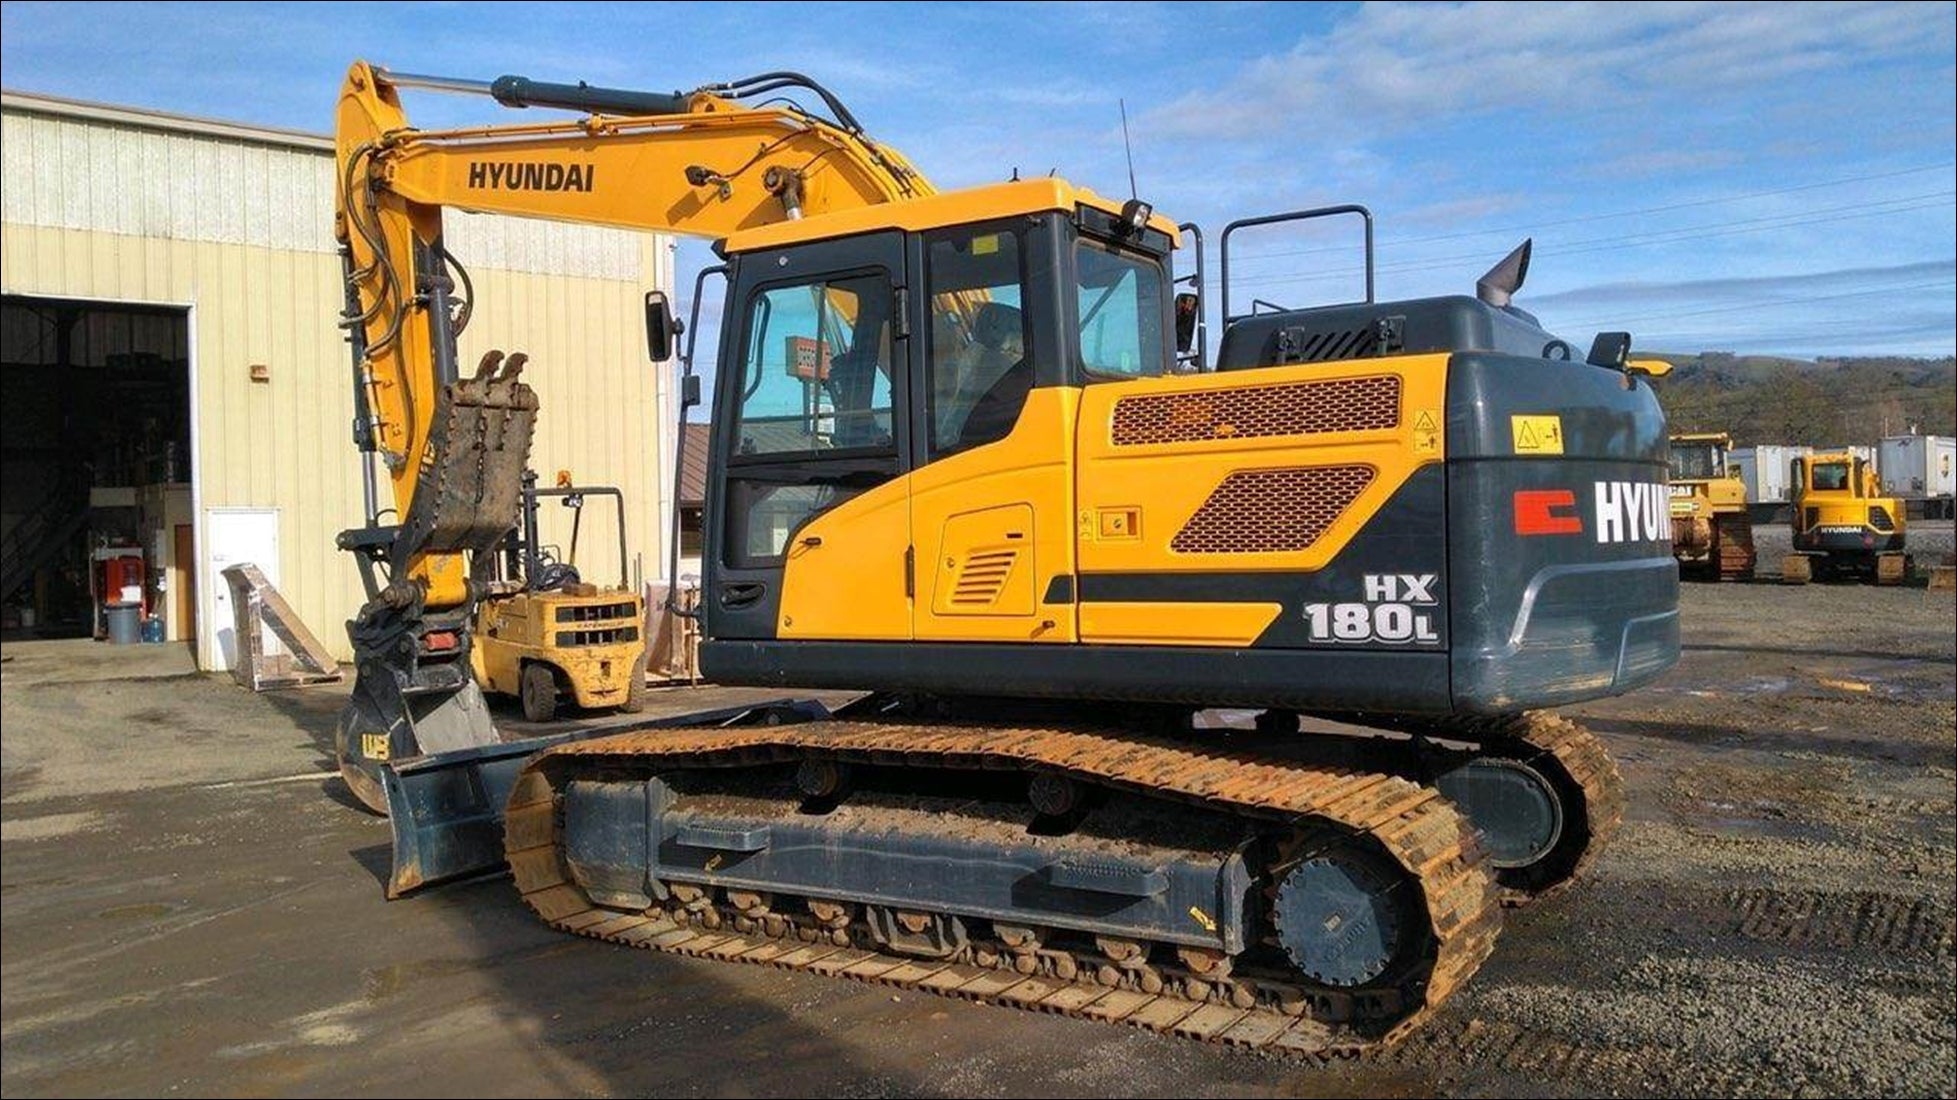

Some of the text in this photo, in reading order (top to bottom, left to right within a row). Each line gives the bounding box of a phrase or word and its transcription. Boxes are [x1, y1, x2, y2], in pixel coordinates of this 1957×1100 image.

[468, 161, 594, 192] HYUNDAI
[1821, 526, 1862, 534] HYUNDAI
[1363, 573, 1438, 605] HX
[1304, 602, 1440, 643] 180L
